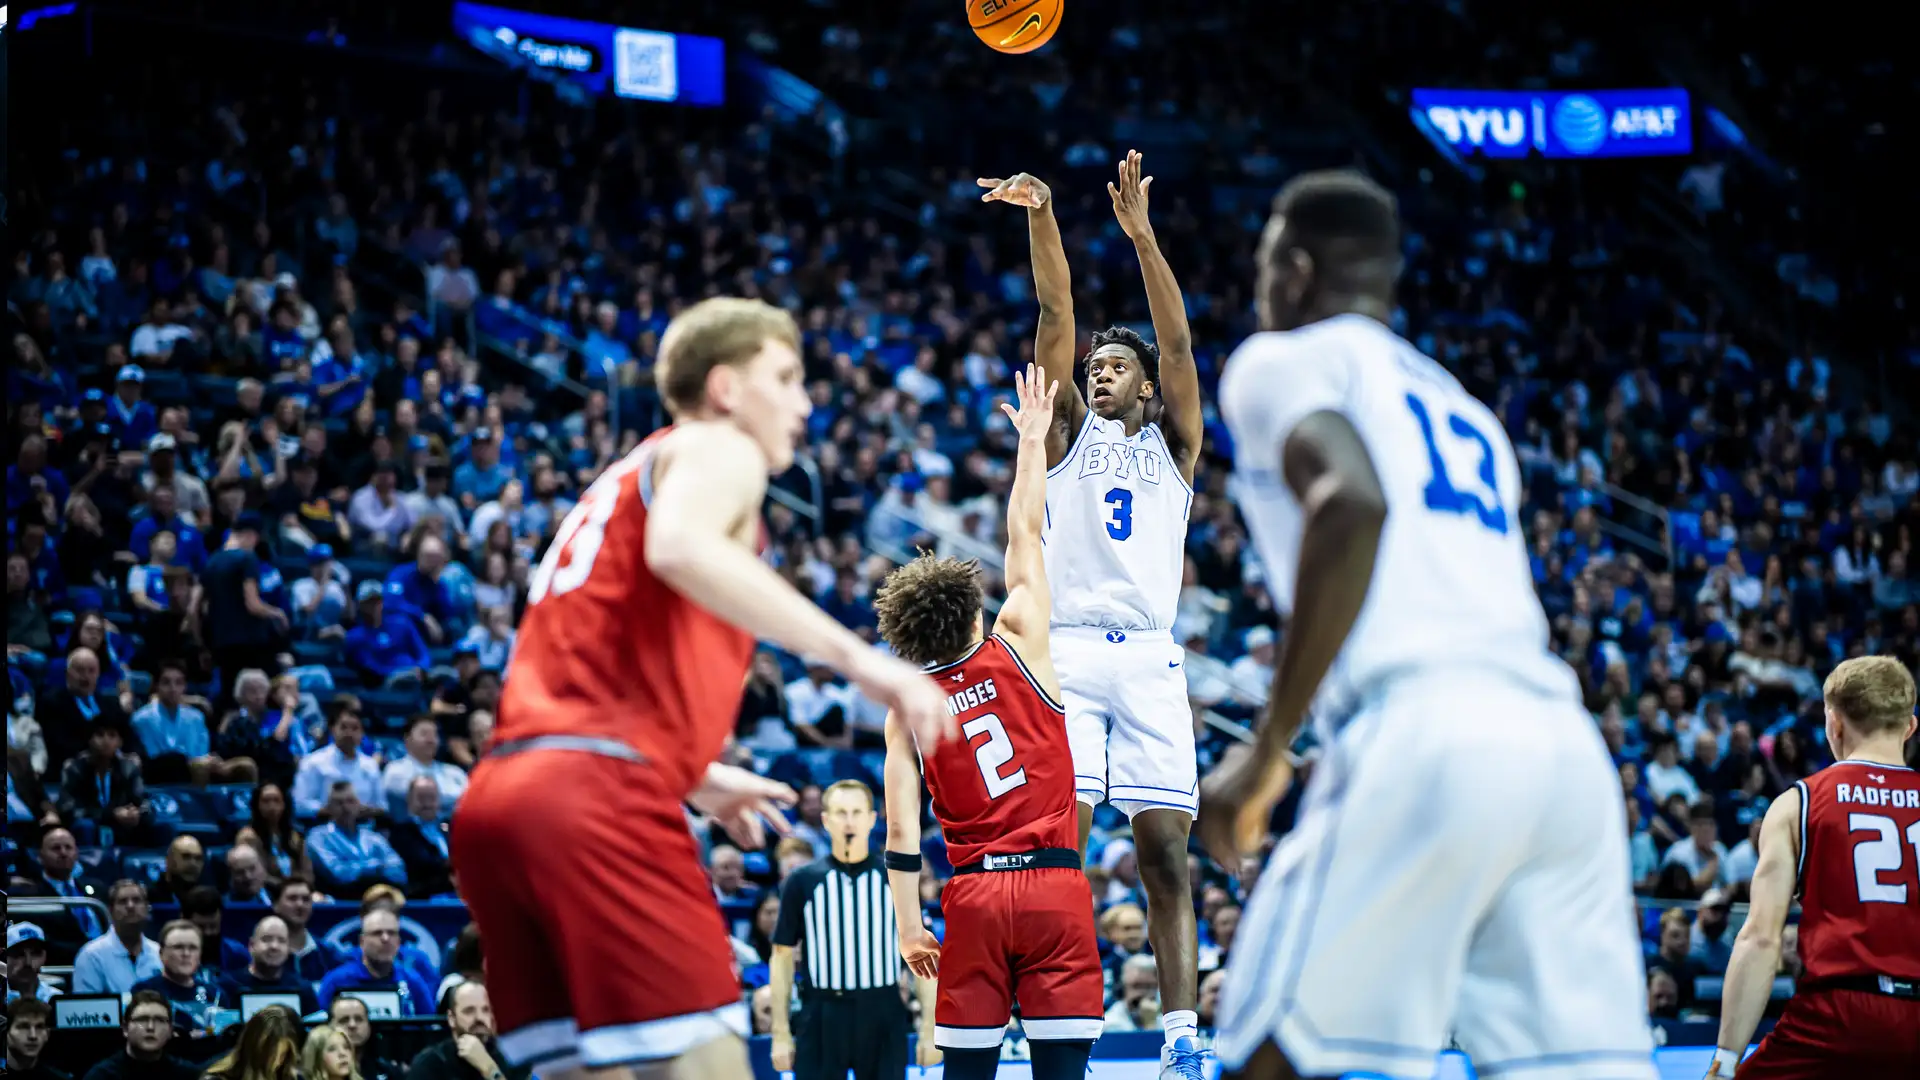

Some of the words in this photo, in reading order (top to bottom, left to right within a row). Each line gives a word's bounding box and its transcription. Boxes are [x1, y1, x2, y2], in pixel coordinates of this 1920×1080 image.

[1078, 442, 1162, 485] BYU
[1104, 487, 1133, 542] 3
[944, 678, 998, 717] MOSES
[961, 712, 1028, 801] 2
[1848, 812, 1920, 904] 21
